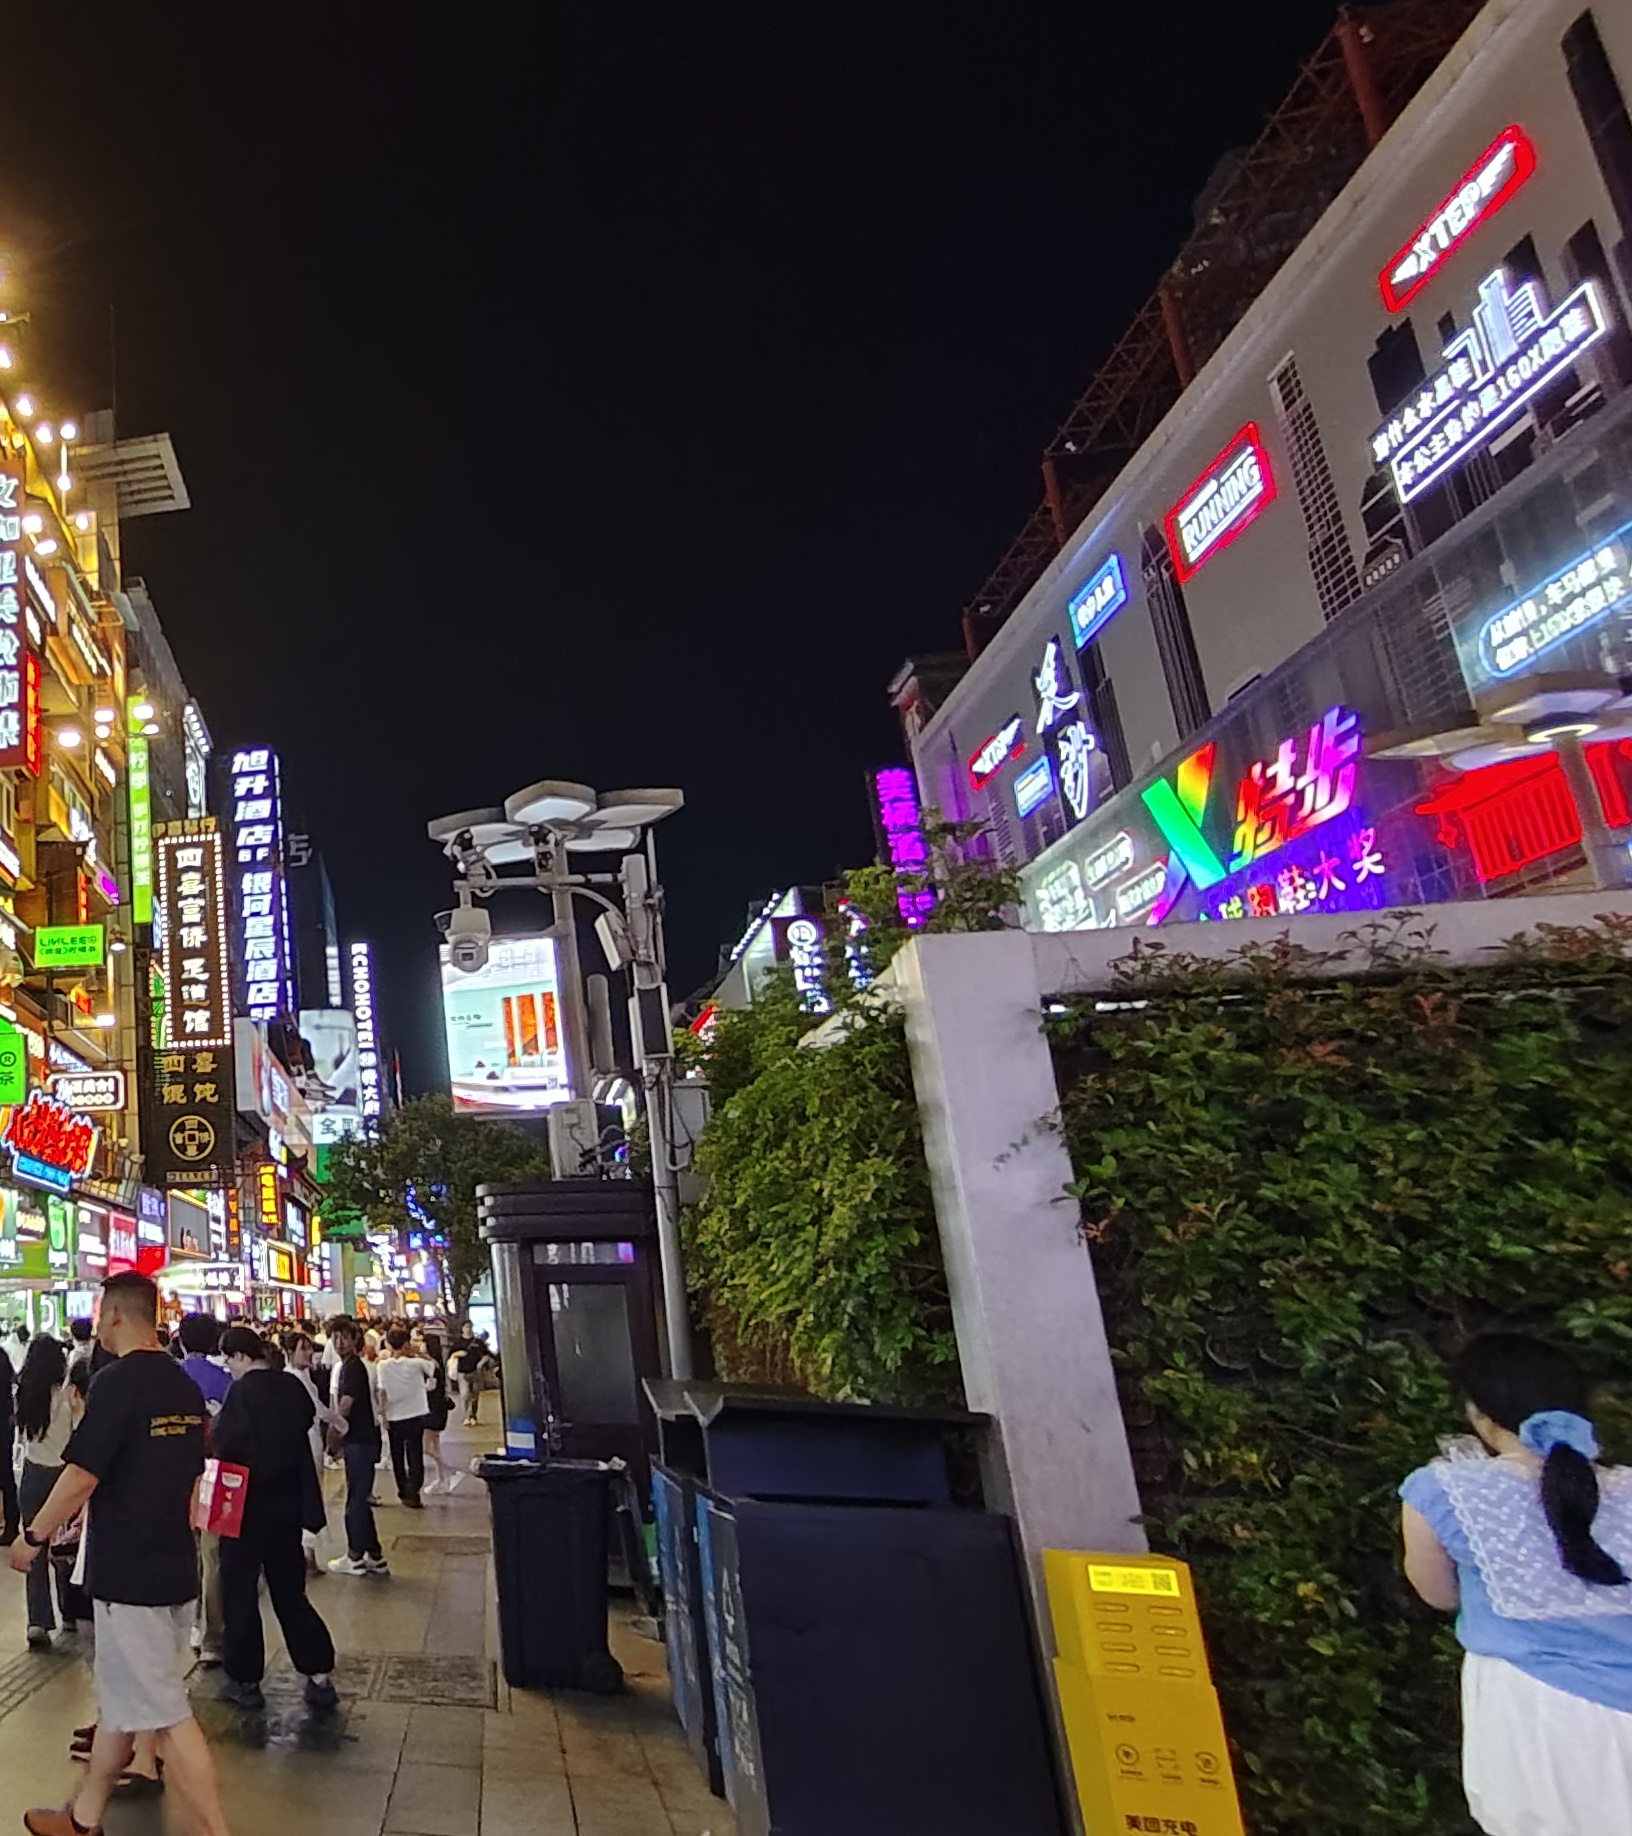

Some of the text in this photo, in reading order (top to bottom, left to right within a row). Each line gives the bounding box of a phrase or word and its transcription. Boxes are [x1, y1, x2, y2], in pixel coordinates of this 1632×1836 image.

[1180, 453, 1264, 553] RUNNING
[231, 749, 275, 847] 旭升酒店
[1200, 826, 1386, 922] 球跑鞋大奖
[241, 871, 280, 1005] 银河星辰酒店
